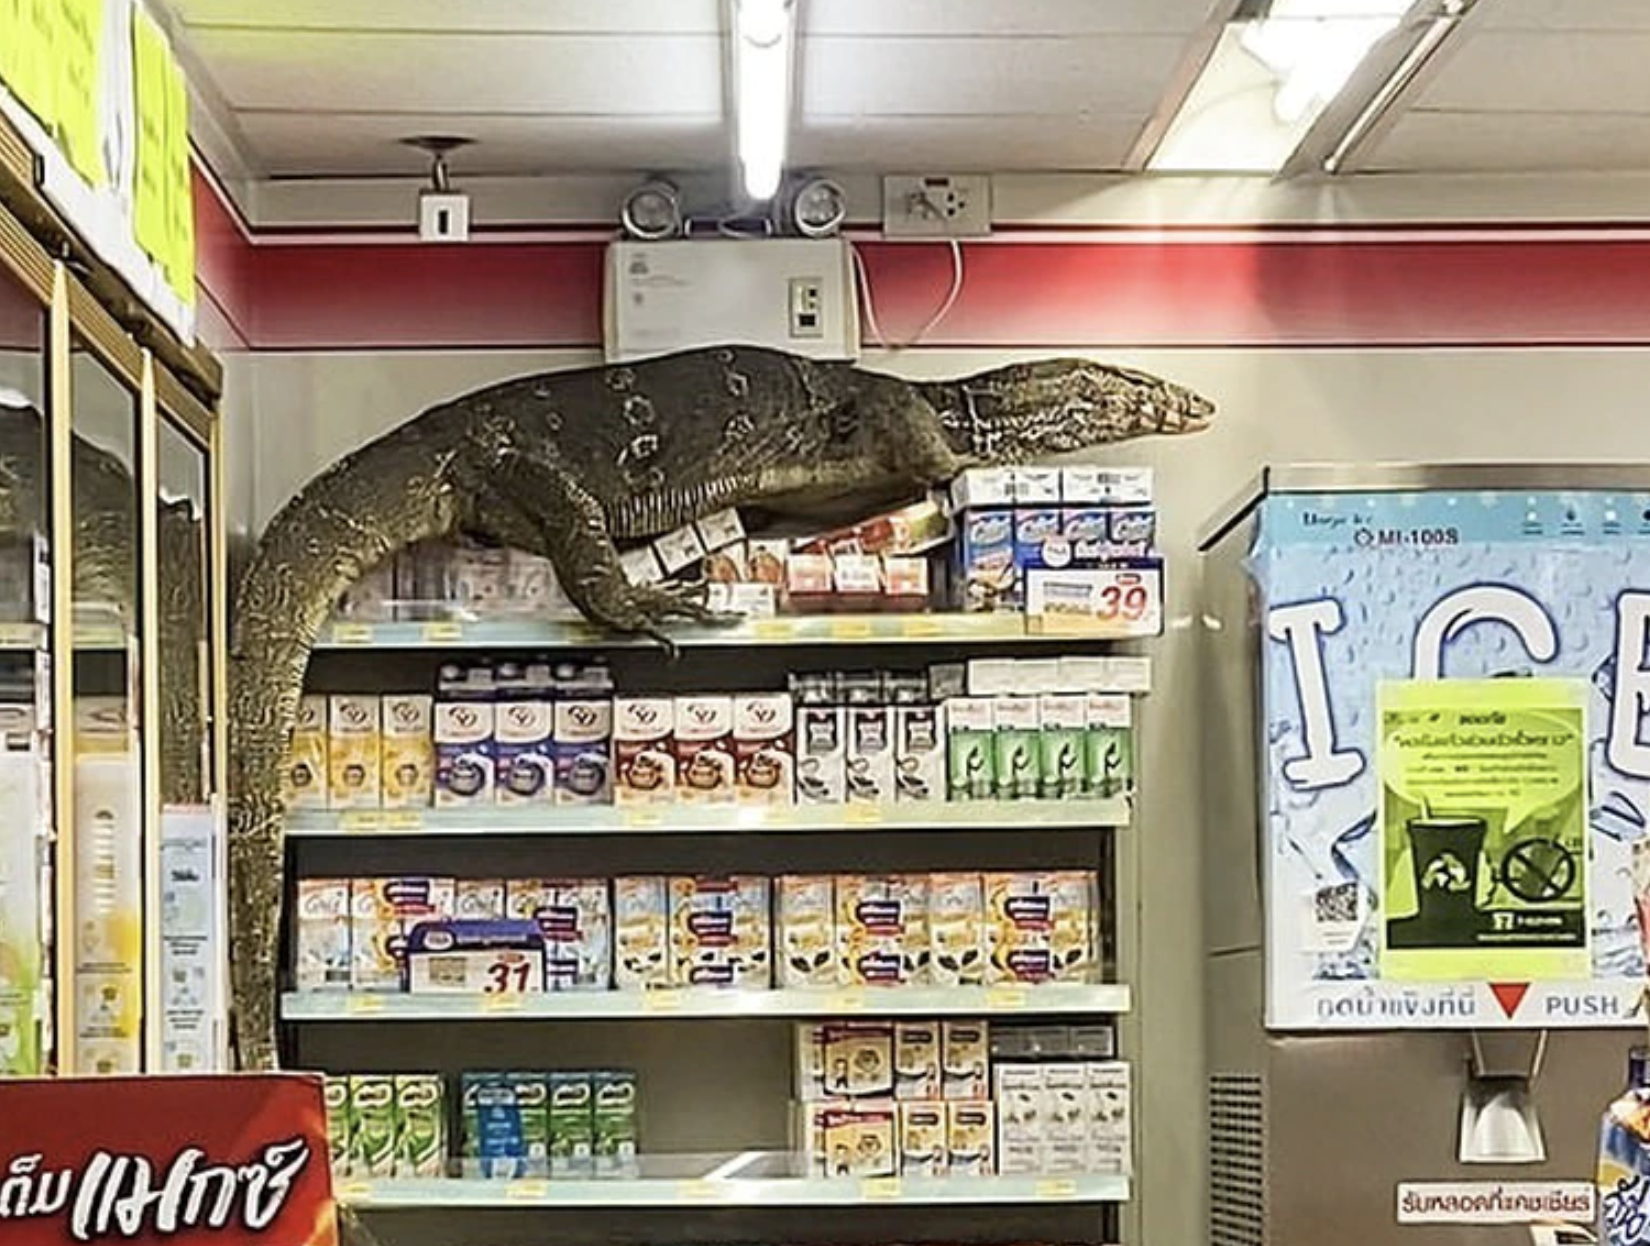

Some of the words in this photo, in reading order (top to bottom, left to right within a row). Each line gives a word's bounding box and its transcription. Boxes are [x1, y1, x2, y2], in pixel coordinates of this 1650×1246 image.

[1097, 586, 1148, 621] 39
[485, 963, 531, 994] 31
[1317, 985, 1476, 1017] กดน้ำแข็งที่นี่
[1545, 995, 1619, 1016] PUSH
